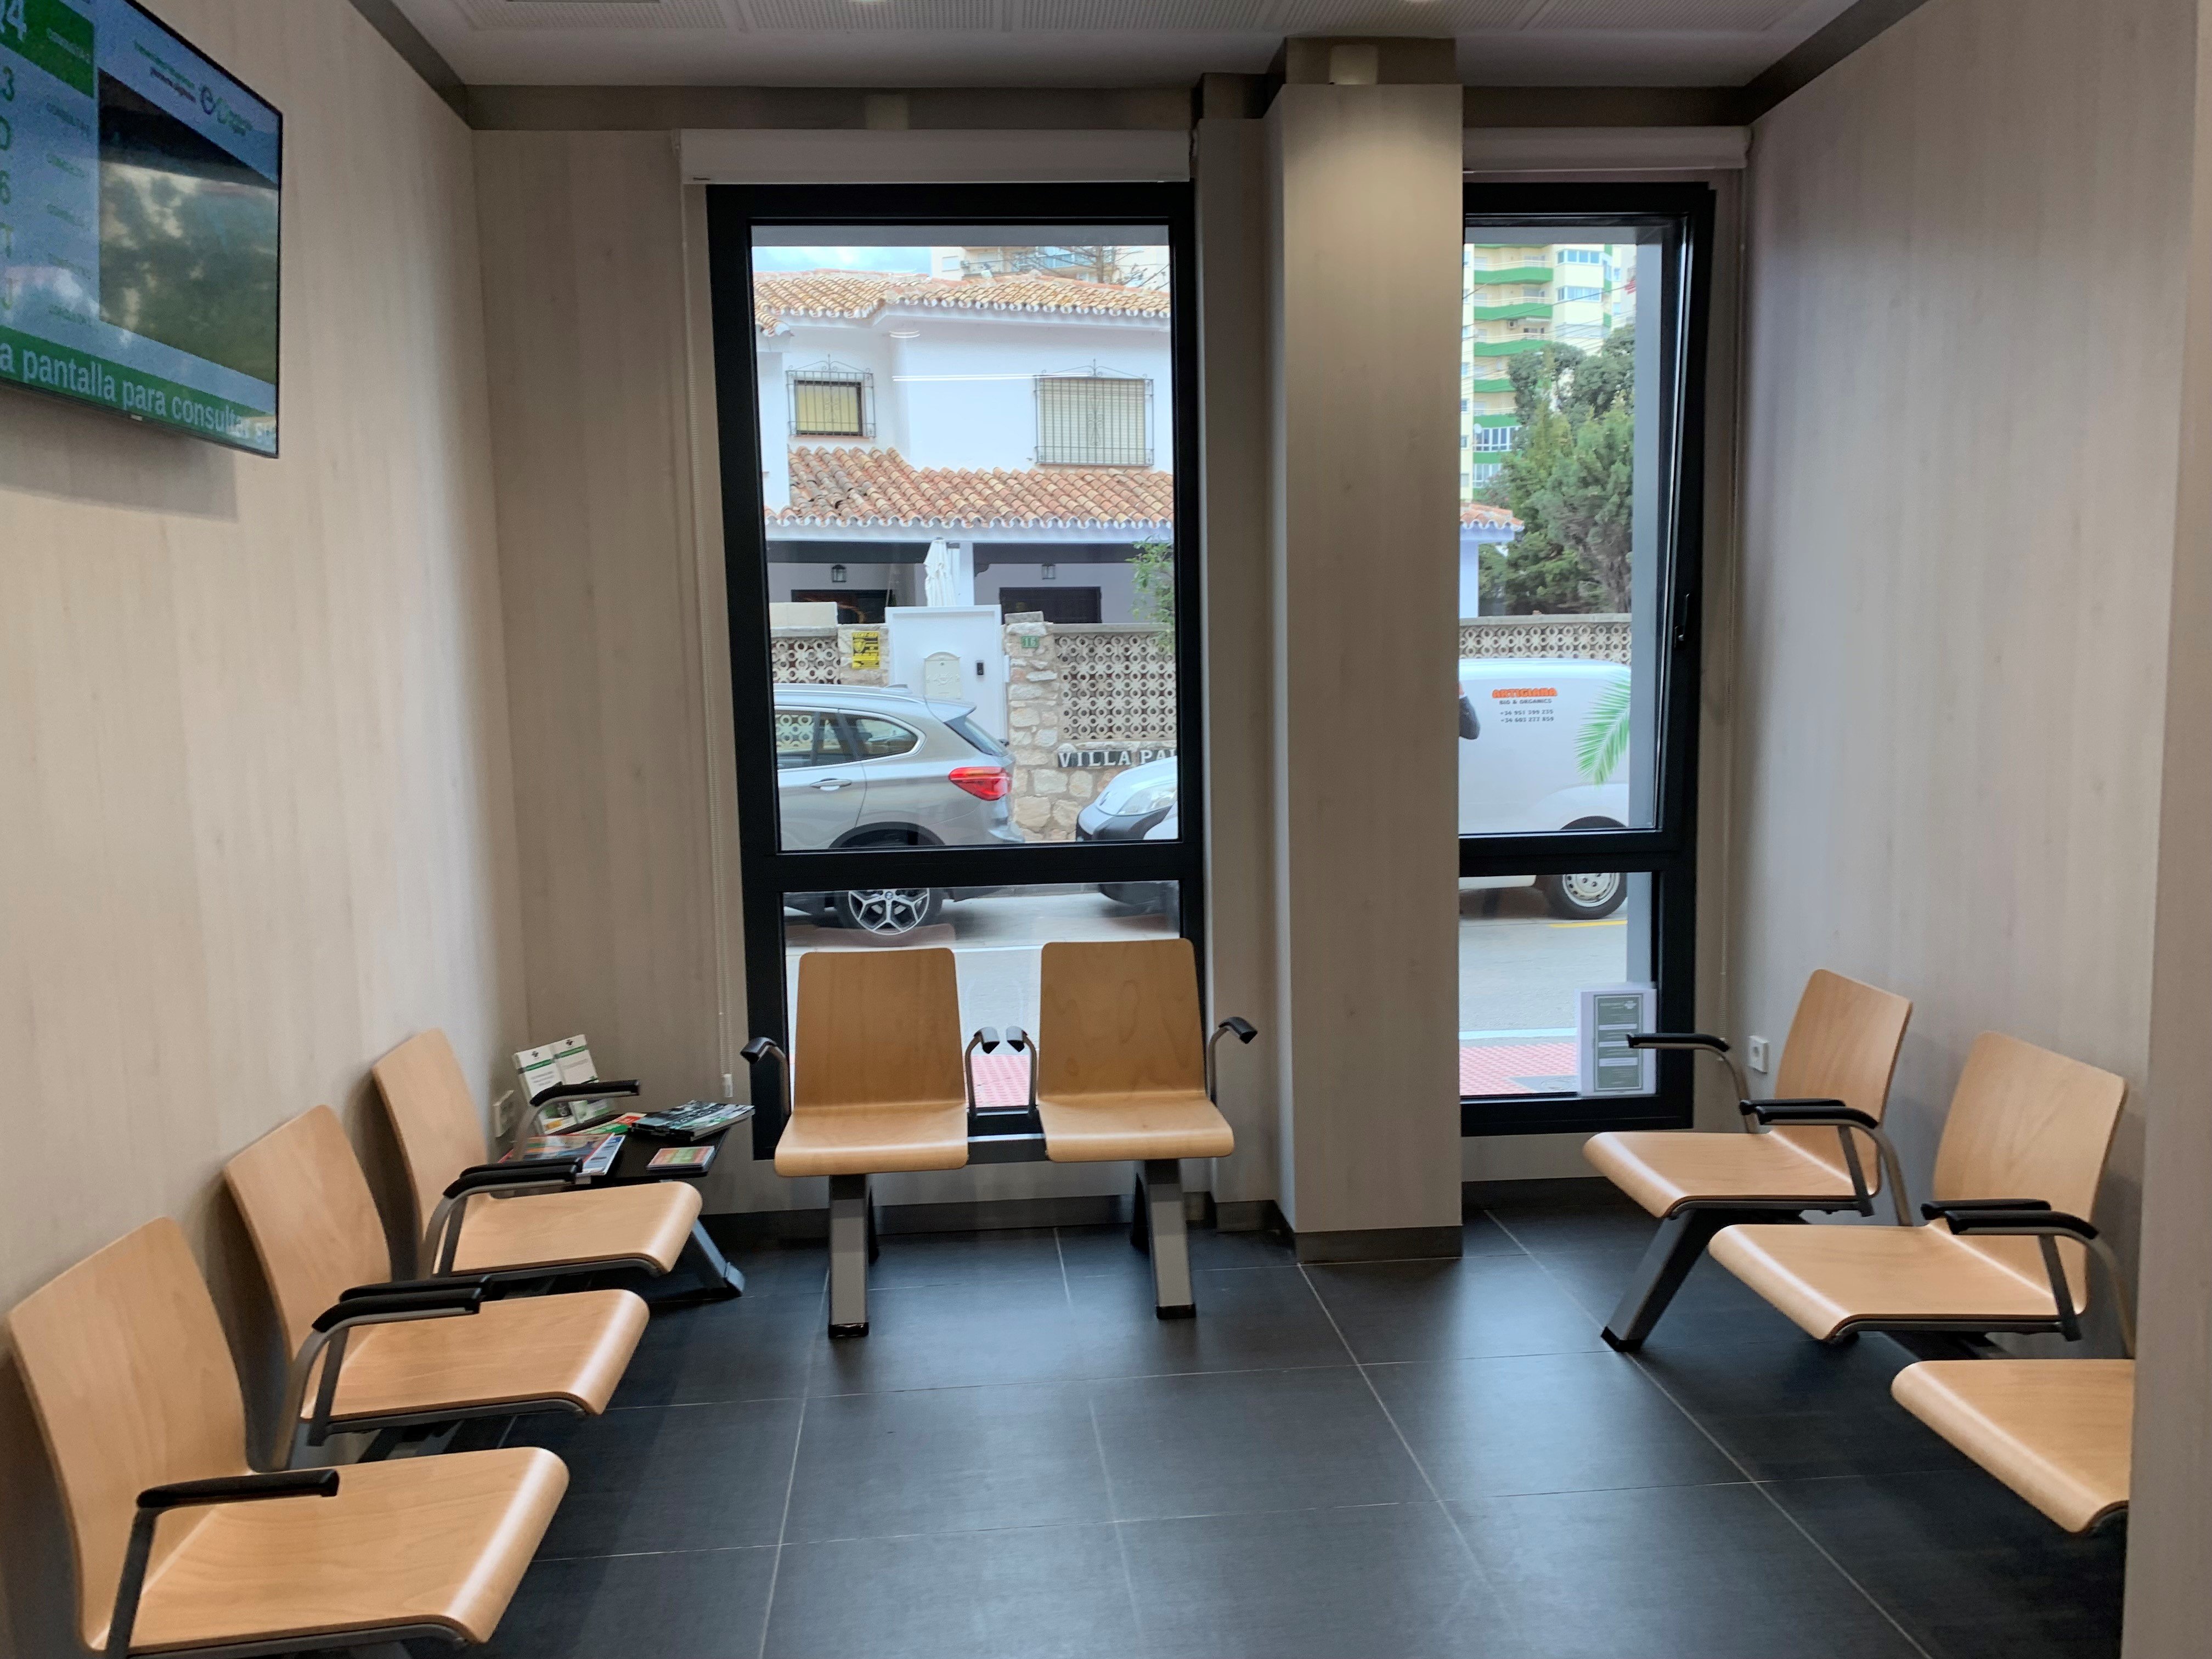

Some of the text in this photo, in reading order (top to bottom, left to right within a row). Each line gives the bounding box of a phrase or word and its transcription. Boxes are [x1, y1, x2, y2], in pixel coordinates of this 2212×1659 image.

[23, 349, 117, 402] pantalla
[122, 380, 166, 416] para
[1058, 751, 1132, 768] VILLA
